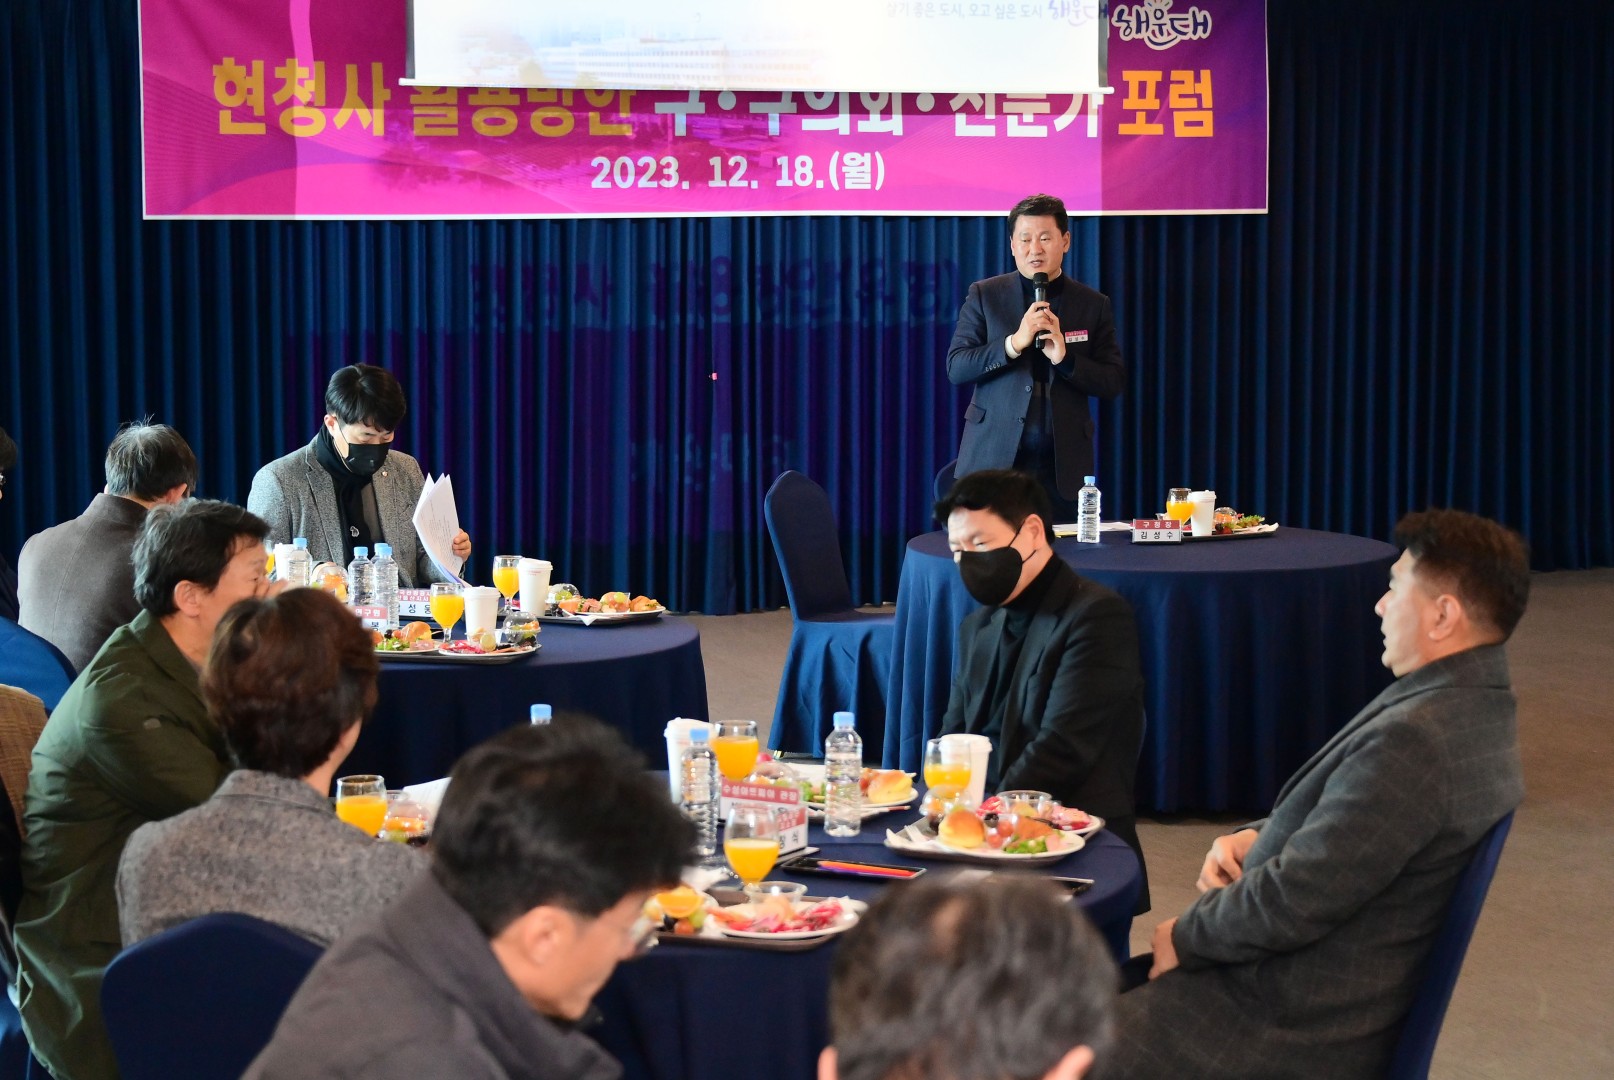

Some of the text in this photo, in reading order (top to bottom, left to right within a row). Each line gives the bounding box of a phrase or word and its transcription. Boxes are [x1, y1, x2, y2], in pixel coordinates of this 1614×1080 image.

[913, 2, 936, 18] 좋은
[969, 3, 991, 17] 오고
[994, 3, 1017, 20] 싶은
[1021, 3, 1043, 19] 도시
[1114, 4, 1210, 47] 해운대
[213, 57, 391, 137] 현청사
[1118, 69, 1213, 137] 포럼
[590, 156, 690, 190] 2023.
[708, 156, 758, 189] 12.
[1141, 531, 1173, 540] 김성수
